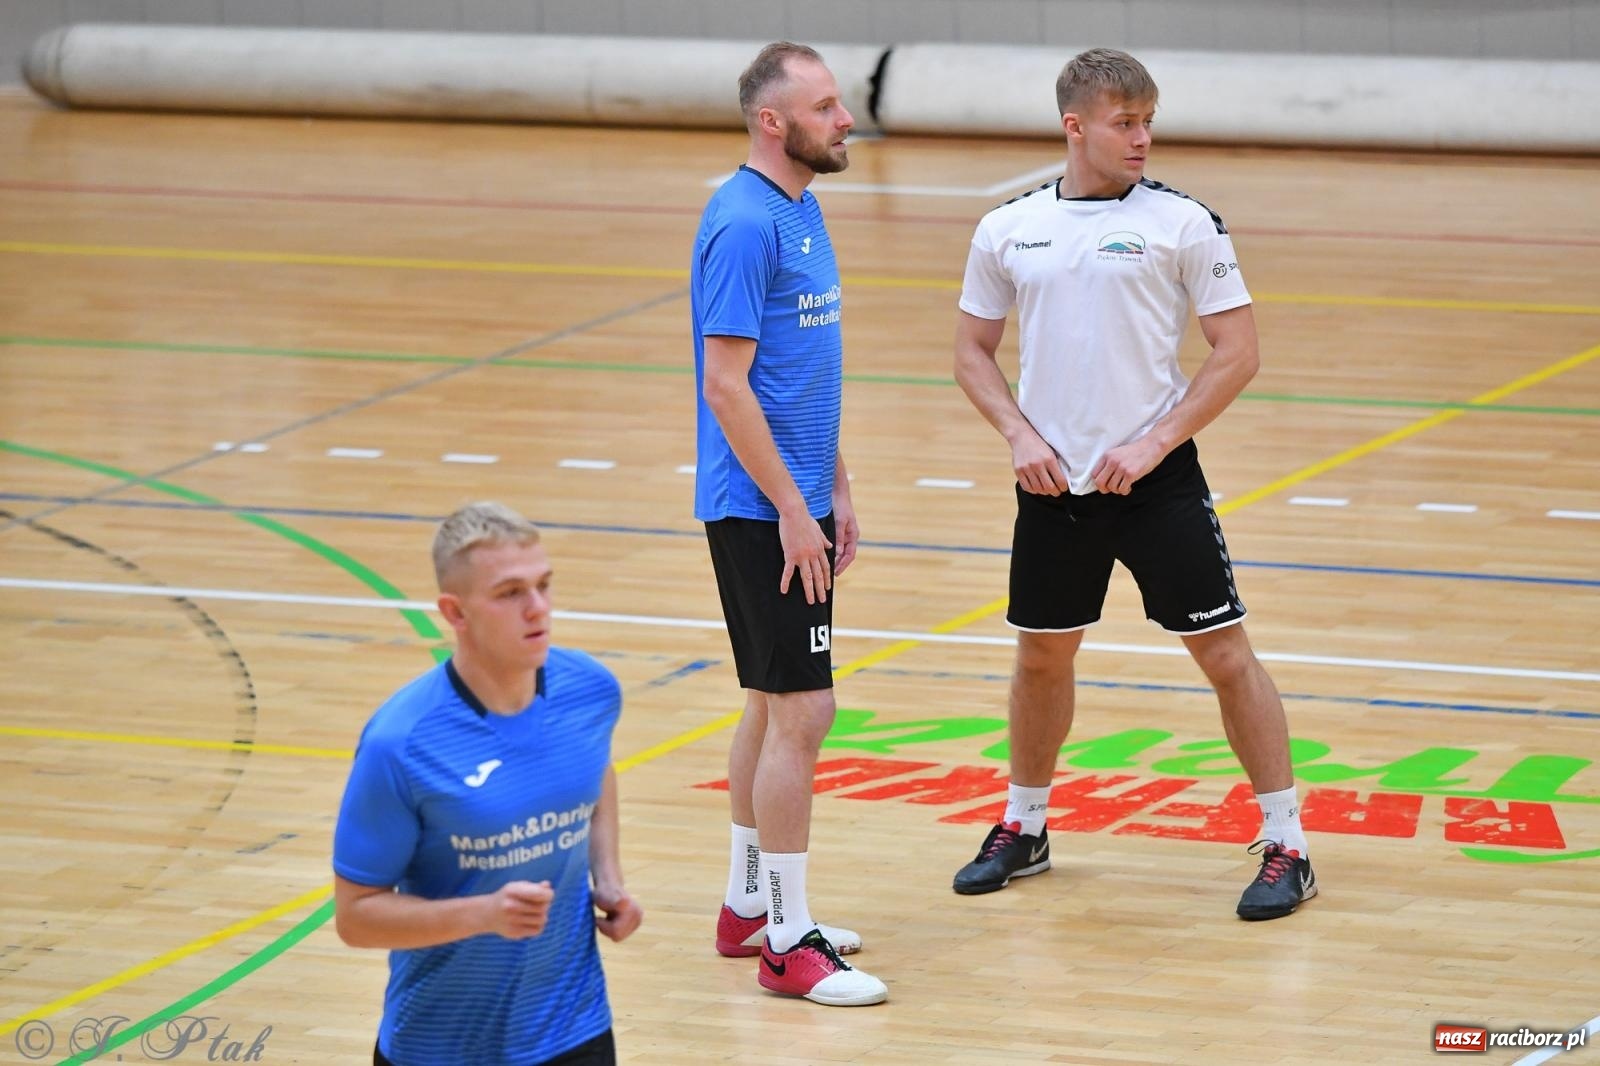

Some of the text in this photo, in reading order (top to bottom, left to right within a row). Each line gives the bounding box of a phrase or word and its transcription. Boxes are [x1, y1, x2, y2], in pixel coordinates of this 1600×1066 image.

[1022, 240, 1052, 250] hummel
[1200, 601, 1231, 620] hummel
[458, 840, 554, 870] Metallbau
[746, 844, 760, 886] PROSKARY
[768, 870, 783, 916] PROSKARY
